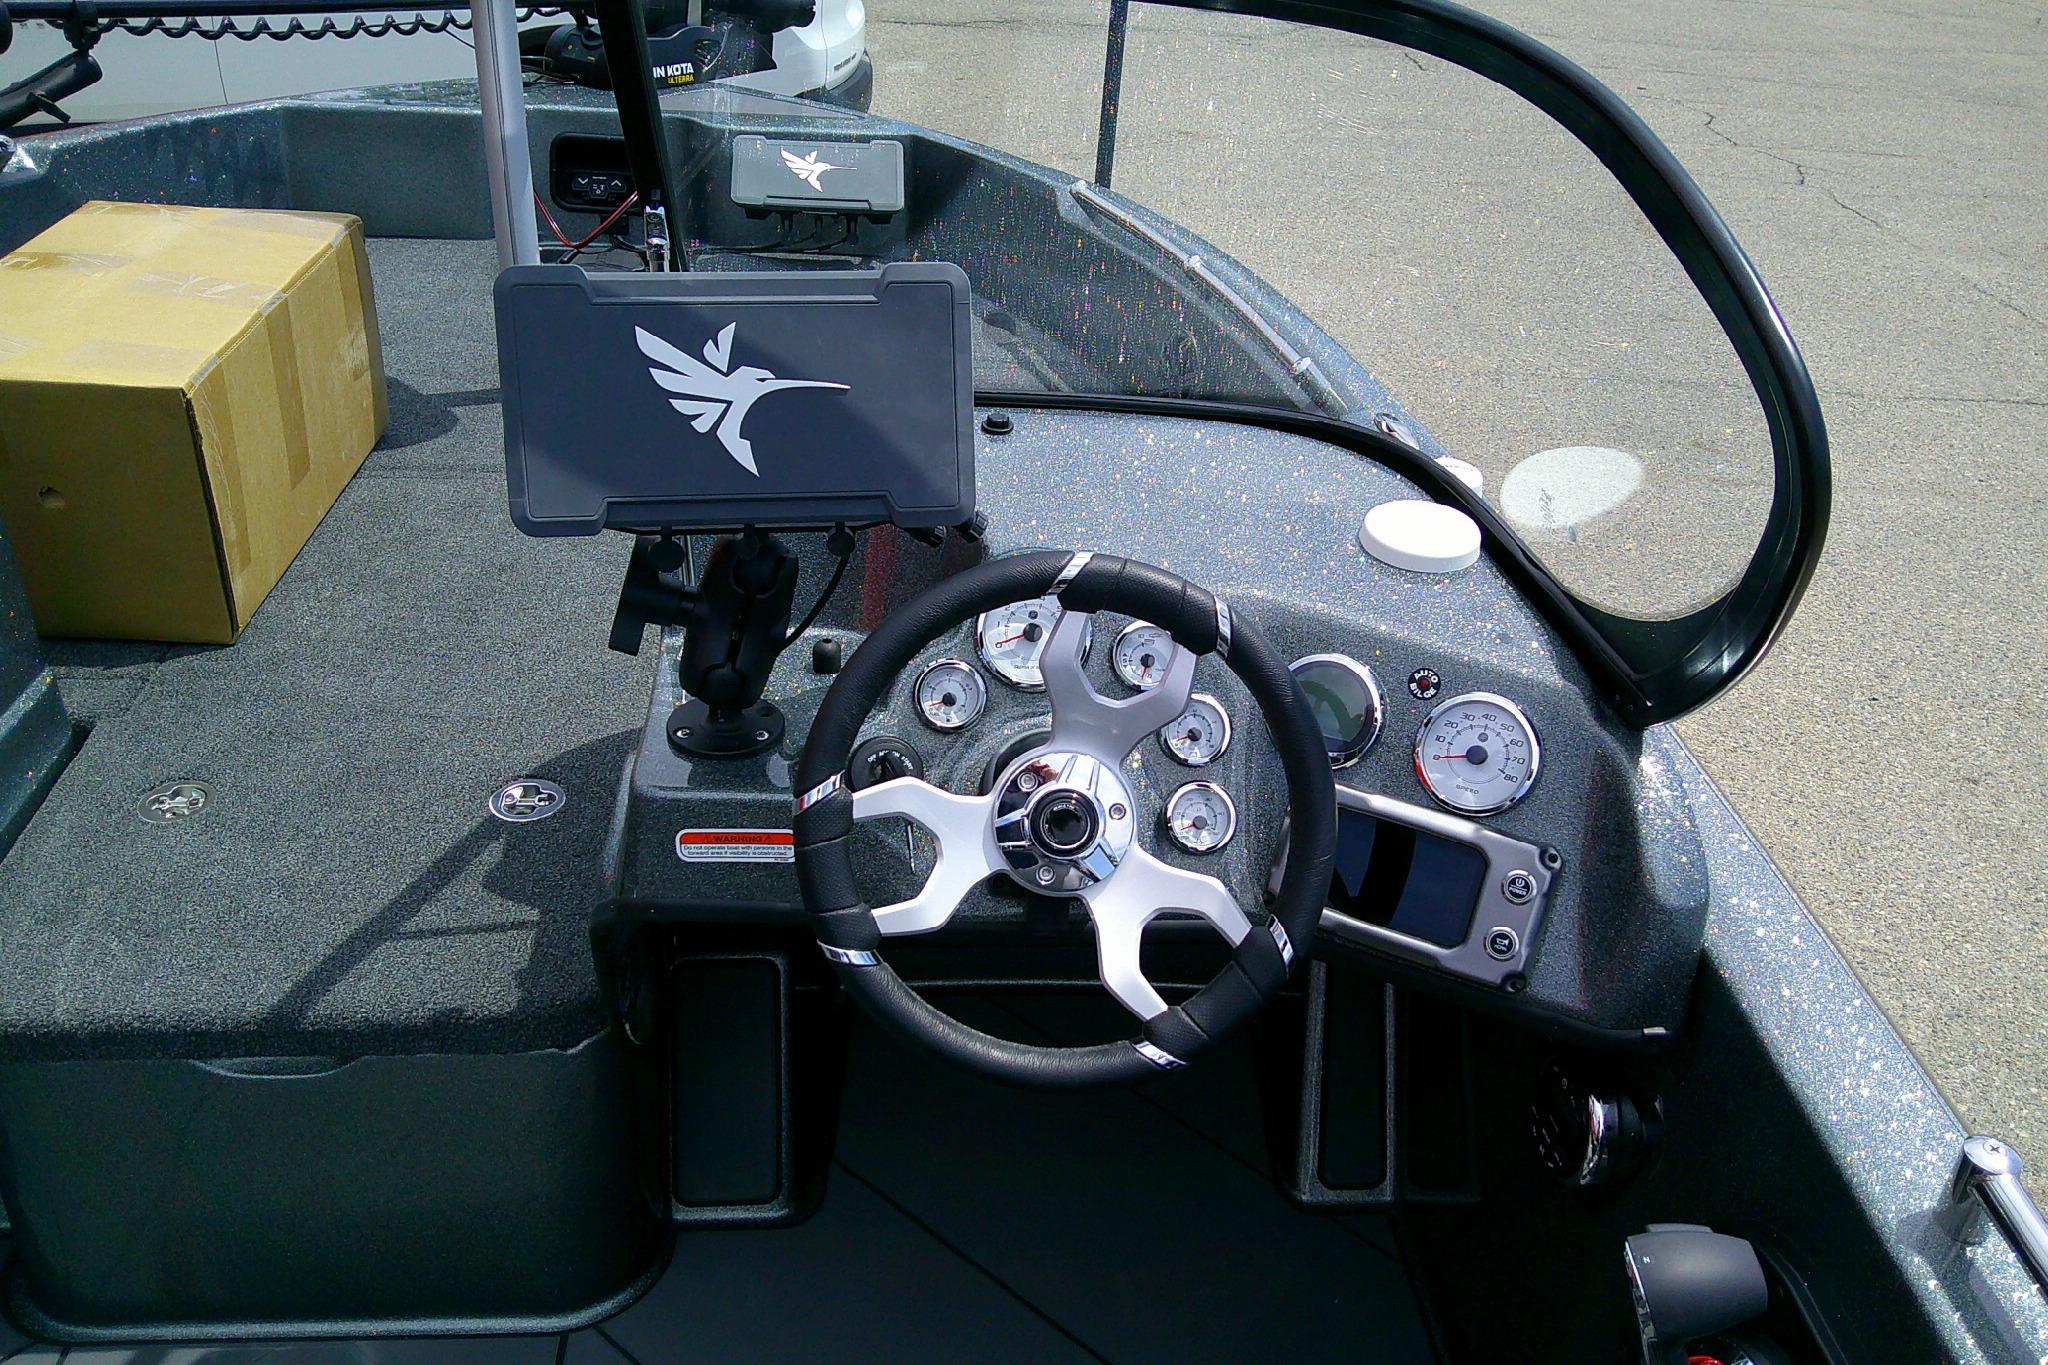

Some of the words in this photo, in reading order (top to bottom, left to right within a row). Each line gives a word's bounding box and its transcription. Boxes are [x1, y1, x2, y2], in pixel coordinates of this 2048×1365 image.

[667, 62, 694, 77] KOTA
[667, 74, 694, 84] ULTERRA
[1414, 670, 1439, 683] AUTO
[1410, 682, 1437, 698] BILGE
[1460, 712, 1476, 722] 30
[1481, 713, 1497, 722] 40
[1443, 720, 1459, 729] 20
[1500, 723, 1515, 733] 50
[1435, 735, 1446, 743] 10
[1510, 738, 1524, 748] 60
[1512, 756, 1526, 765] 70
[1503, 773, 1519, 784] 80
[1456, 784, 1479, 795] SPEED
[714, 835, 763, 843] WARNING
[1508, 886, 1527, 896] POWER
